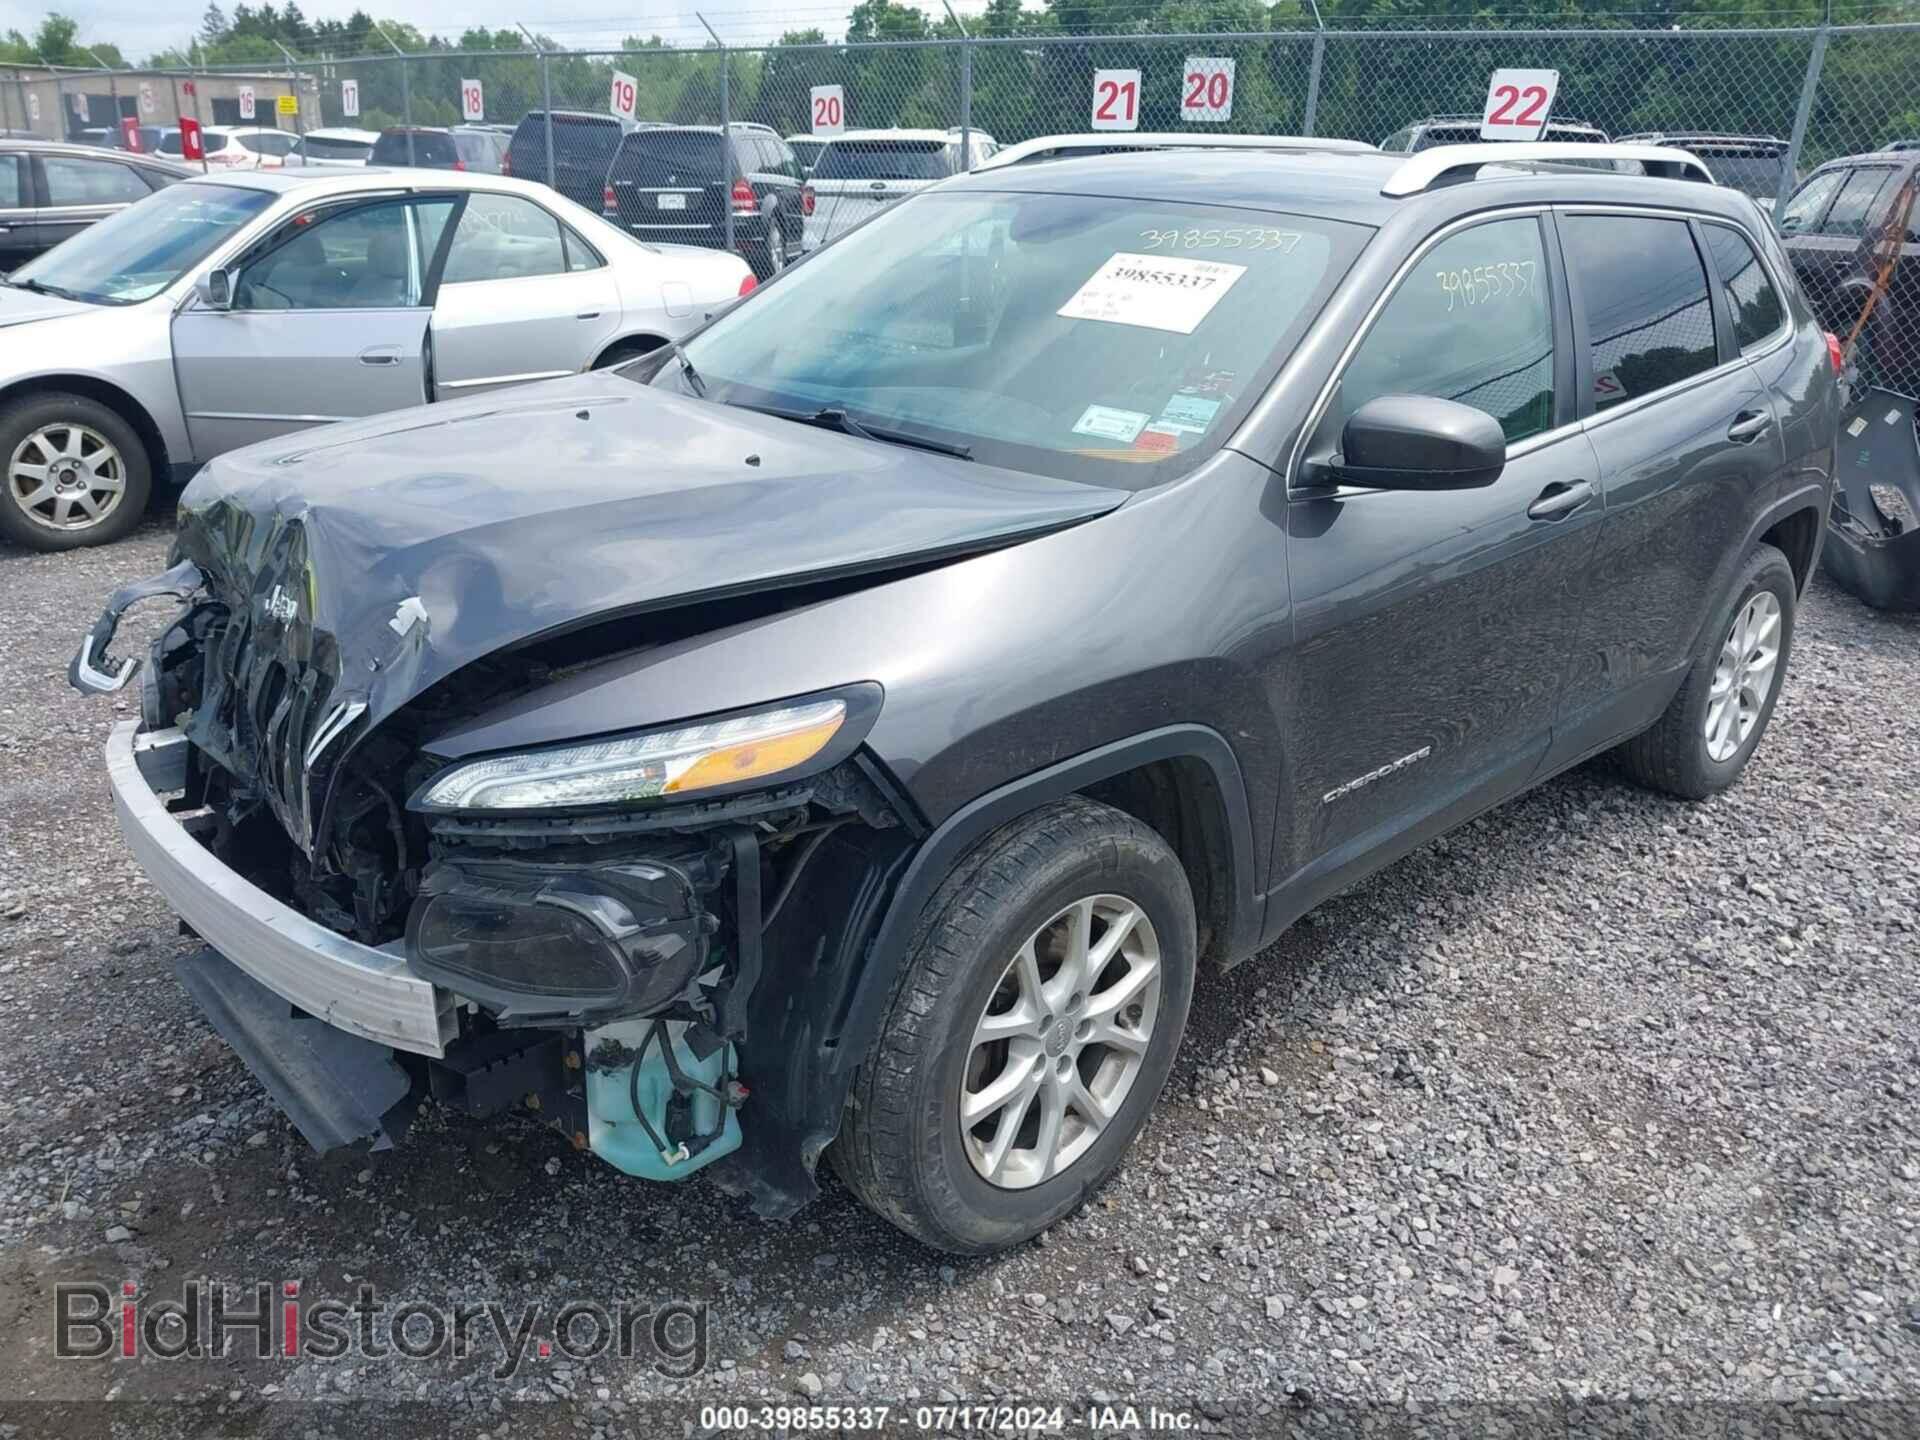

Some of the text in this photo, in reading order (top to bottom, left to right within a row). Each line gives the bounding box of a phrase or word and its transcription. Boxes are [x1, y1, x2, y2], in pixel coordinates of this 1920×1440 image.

[241, 92, 253, 113] 16
[344, 87, 356, 111] 17
[464, 87, 481, 113] 18
[614, 80, 633, 112] 19
[1096, 80, 1136, 121] 21
[1184, 73, 1229, 108] 20
[1488, 85, 1548, 126] 22
[814, 96, 841, 127] 20
[1139, 228, 1303, 254] 39855337
[1436, 258, 1536, 312] 39855337
